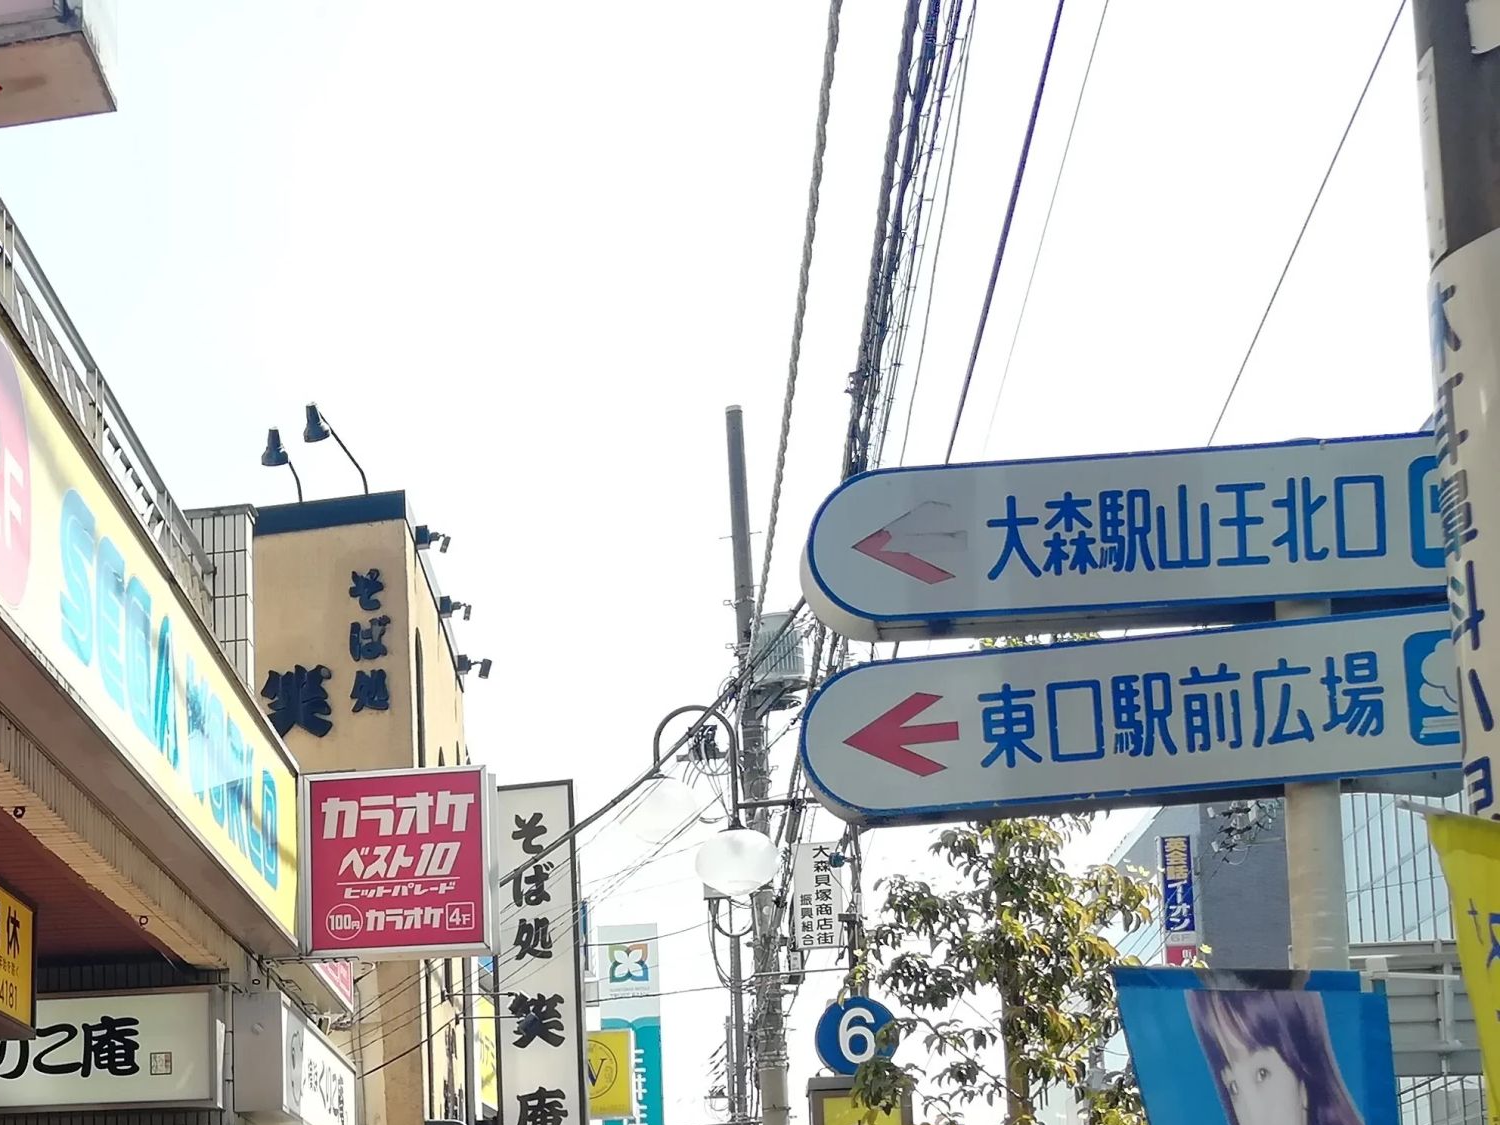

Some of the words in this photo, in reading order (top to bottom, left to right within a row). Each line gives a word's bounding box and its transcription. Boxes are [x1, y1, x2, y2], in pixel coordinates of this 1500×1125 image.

[986, 475, 1387, 581] 大森駅山王北口
[60, 487, 178, 770] SEGA
[187, 652, 280, 893] WORLD
[978, 650, 1385, 768] 東口駅前広場
[321, 790, 475, 839] カラオケ
[338, 842, 461, 880] ベスト10
[344, 881, 456, 899] ヒットパレード
[812, 844, 835, 945] 大森貝塚商店街
[329, 914, 361, 931] 100円
[365, 906, 444, 932] カラオケ
[449, 908, 471, 926] 4F
[838, 1007, 876, 1064] 6
